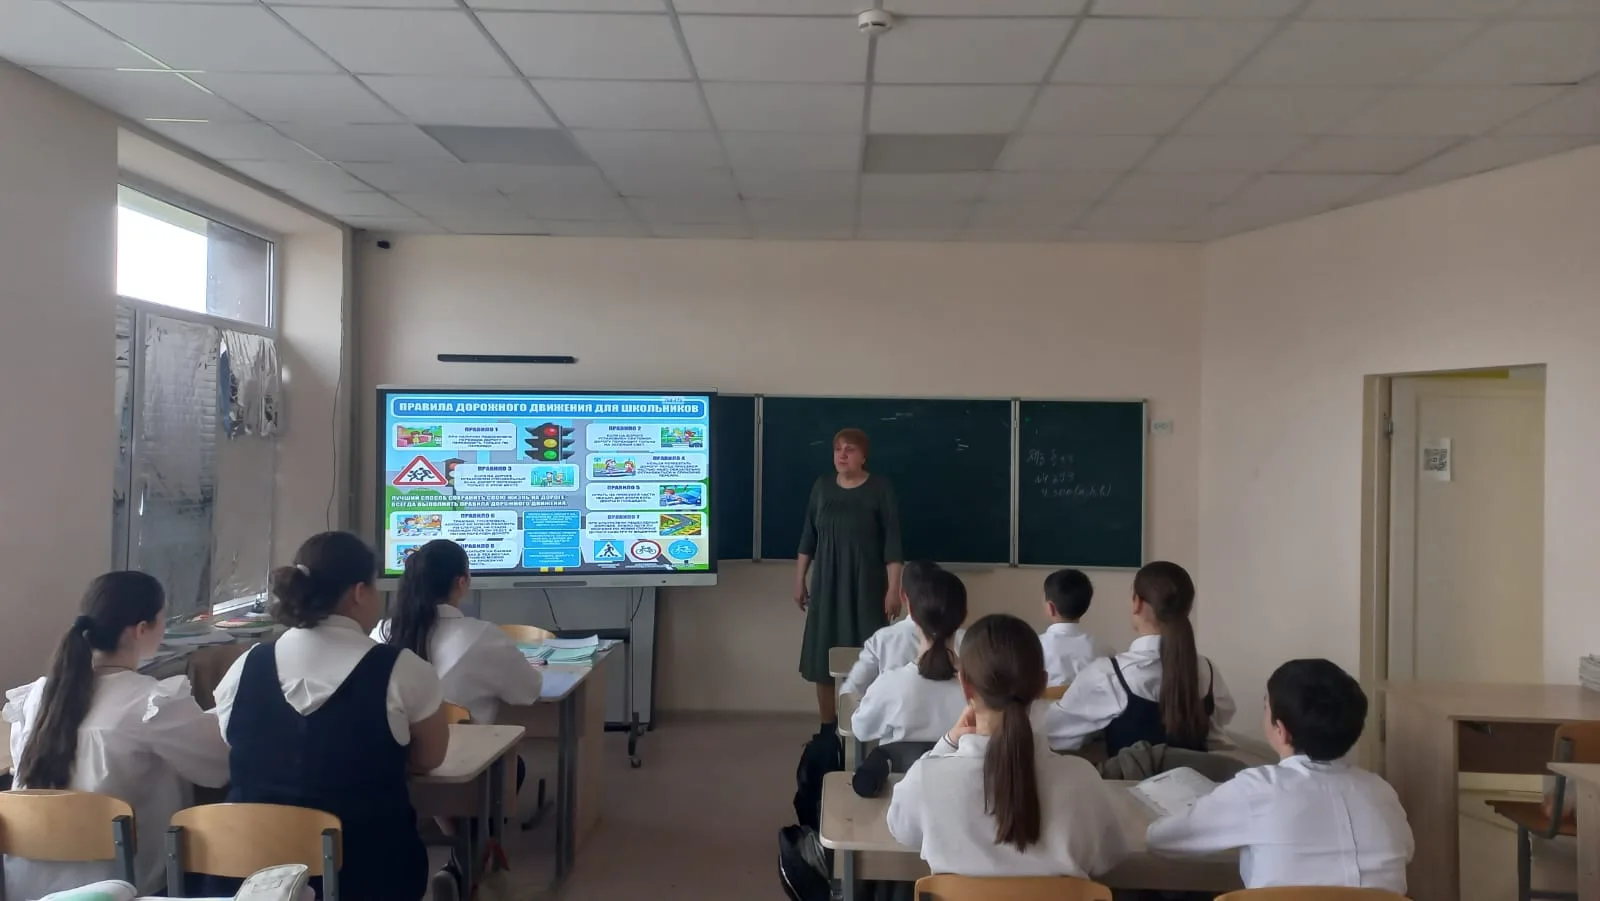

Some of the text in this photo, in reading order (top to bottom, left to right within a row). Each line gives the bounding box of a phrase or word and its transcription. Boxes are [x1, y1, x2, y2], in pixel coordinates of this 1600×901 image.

[399, 402, 699, 413] ПРАВИЛА ДОРОЖНОГО ДВИЖЕНИЯ ДЛЯ ШКОЛЬНИКОВ
